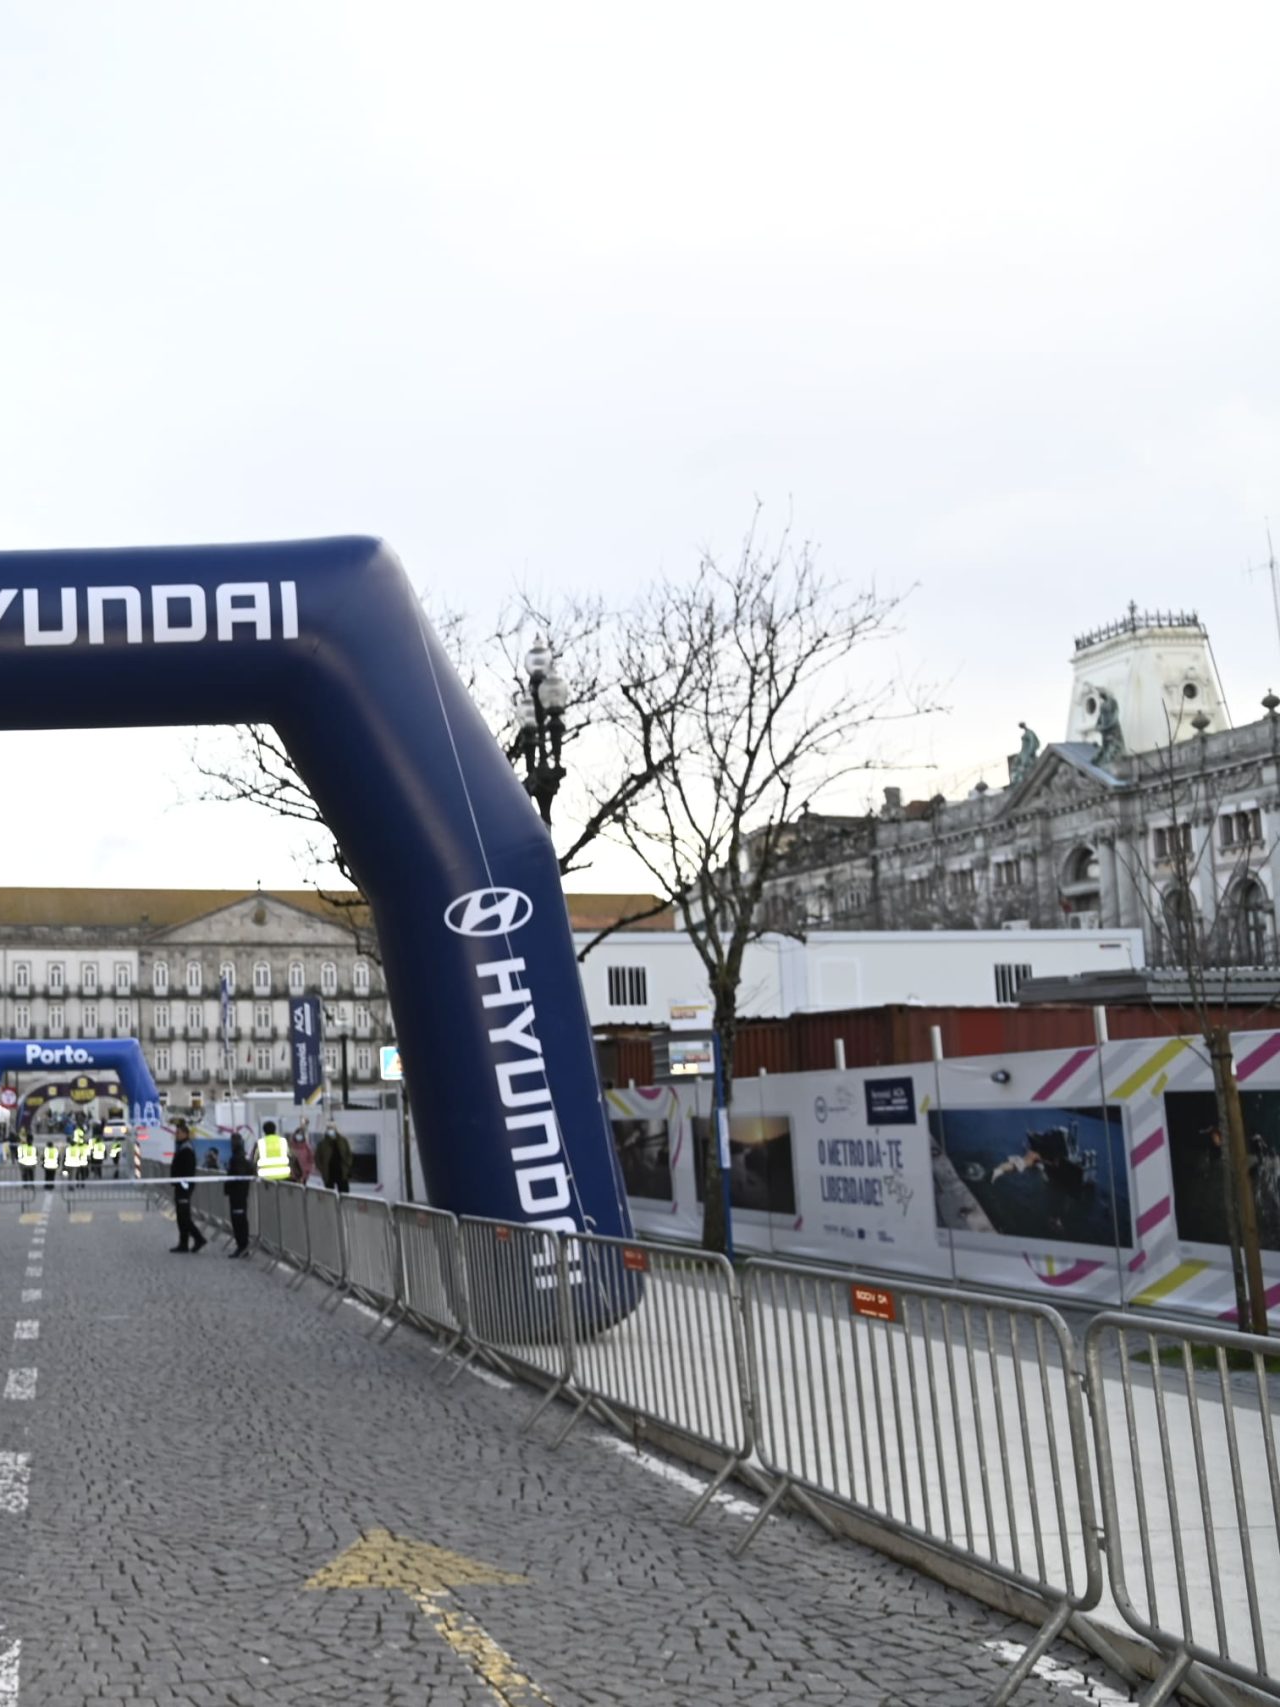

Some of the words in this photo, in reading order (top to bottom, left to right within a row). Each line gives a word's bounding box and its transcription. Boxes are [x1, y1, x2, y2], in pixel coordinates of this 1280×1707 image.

[26, 1044, 94, 1064] Porto.
[818, 1139, 826, 1166] O
[827, 1138, 865, 1167] METRO
[821, 1175, 884, 1206] LIBERDADE!
